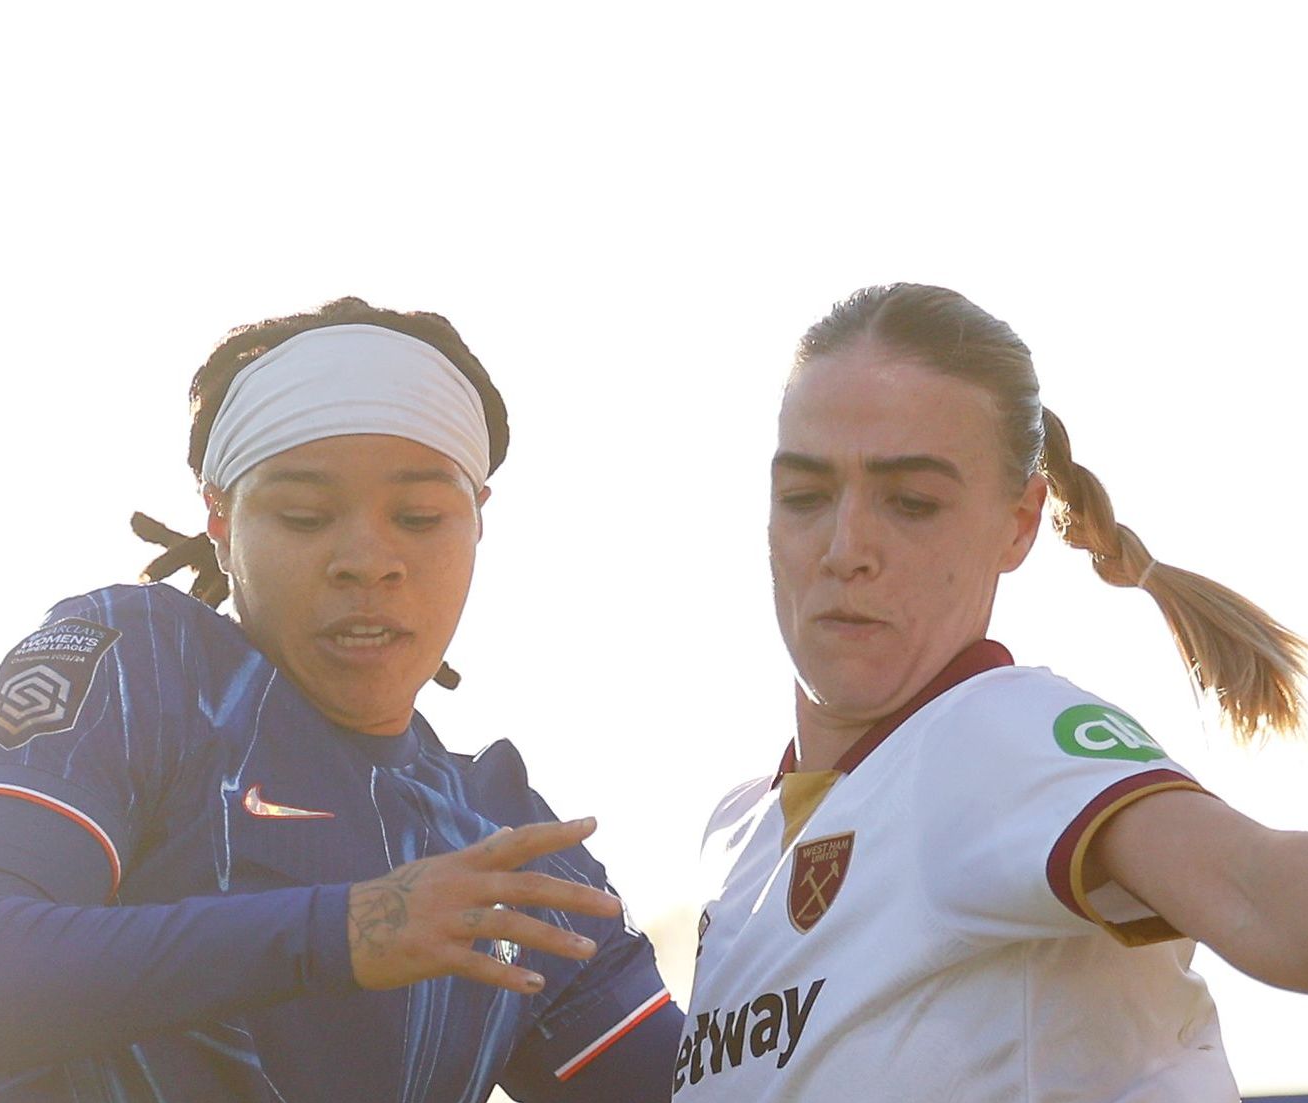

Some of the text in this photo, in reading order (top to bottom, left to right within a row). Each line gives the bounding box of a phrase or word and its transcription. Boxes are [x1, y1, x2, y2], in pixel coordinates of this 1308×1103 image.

[21, 633, 99, 649] WOMEN'S
[49, 643, 95, 653] LEAGUE
[673, 978, 827, 1095] etway
